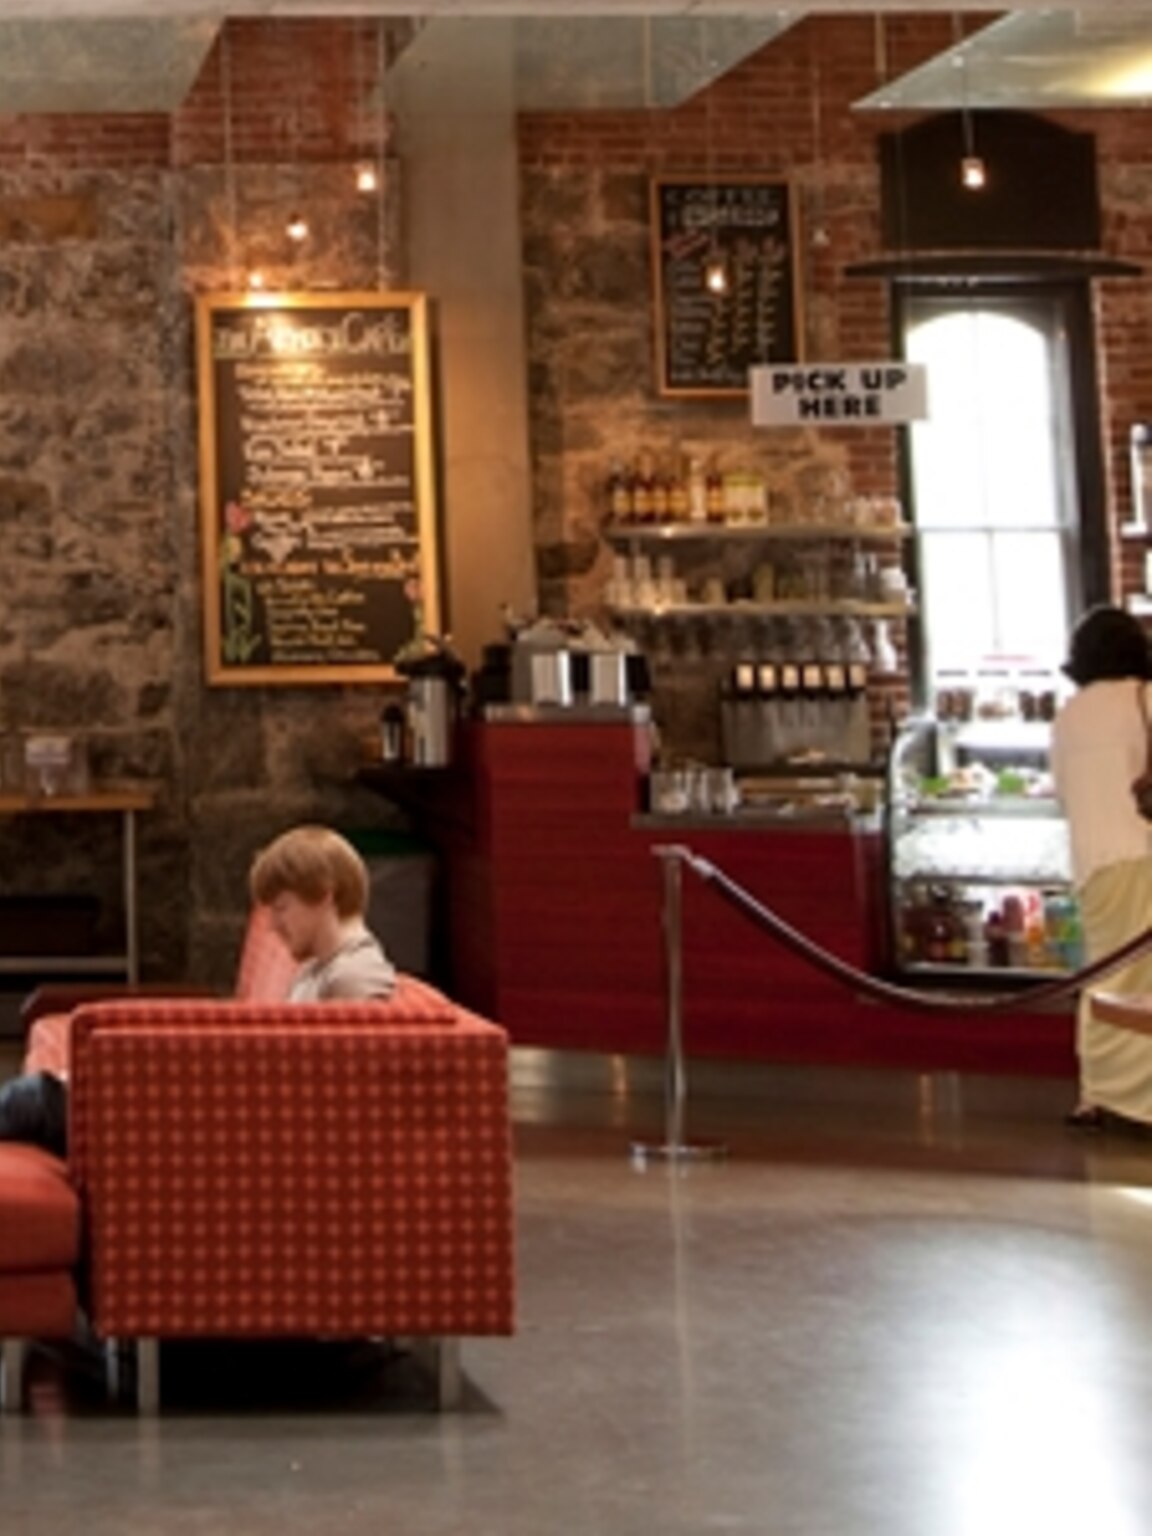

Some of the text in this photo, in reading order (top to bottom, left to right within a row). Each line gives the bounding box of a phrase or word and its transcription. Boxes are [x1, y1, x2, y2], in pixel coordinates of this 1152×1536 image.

[773, 369, 846, 394] PICK
[860, 368, 907, 391] UP
[799, 394, 881, 418] HERE
